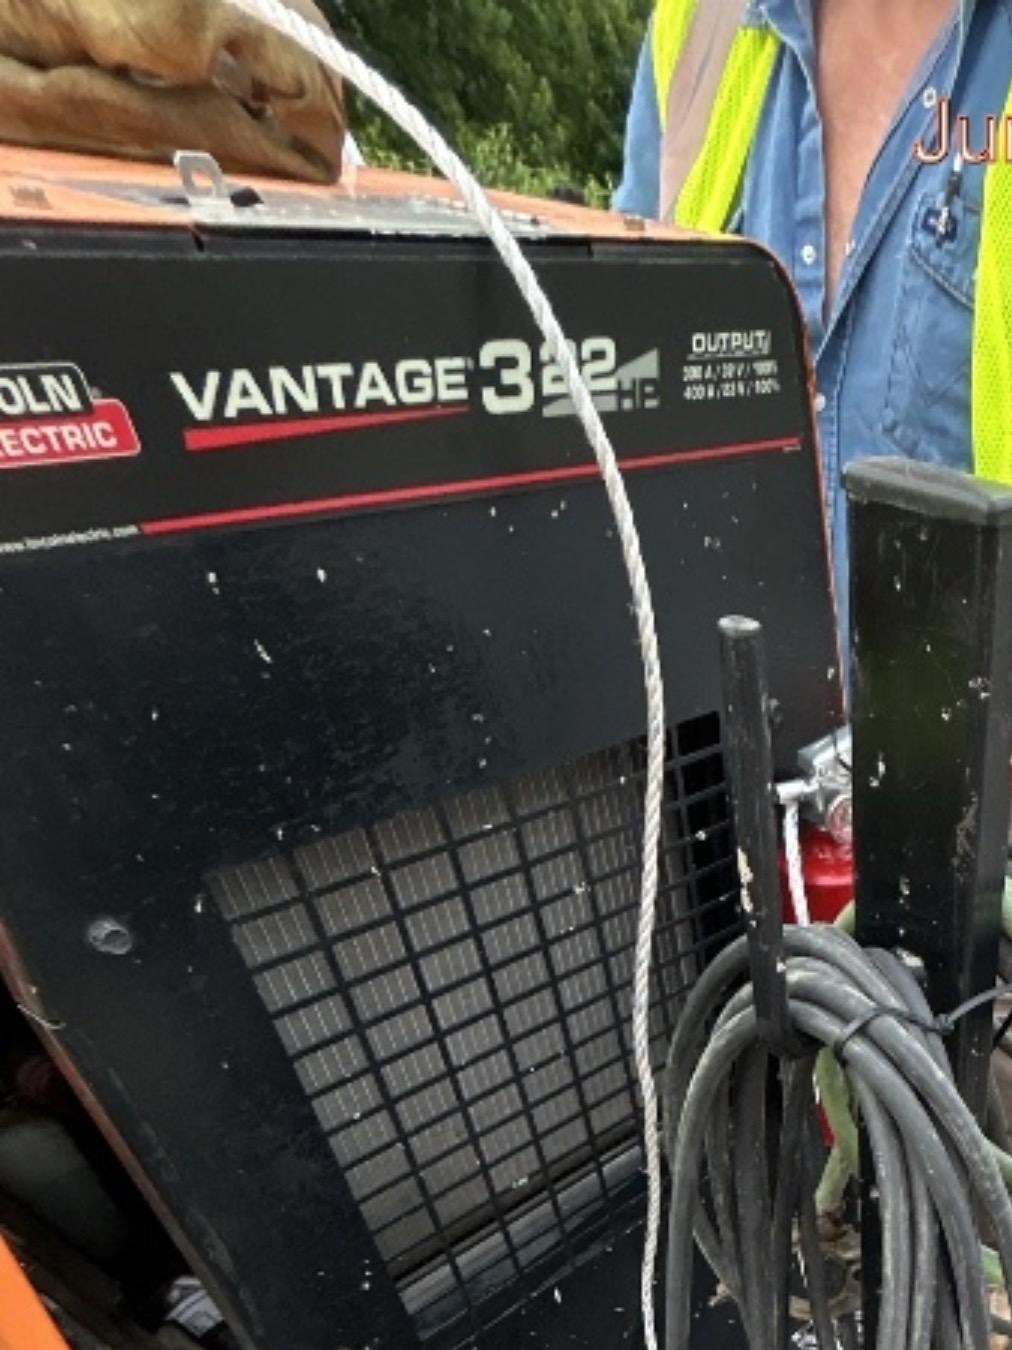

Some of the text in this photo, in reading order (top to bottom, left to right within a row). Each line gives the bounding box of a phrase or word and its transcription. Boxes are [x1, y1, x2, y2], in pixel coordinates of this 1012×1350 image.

[692, 330, 766, 352] OUTPUT
[169, 356, 470, 421] VANTAGE
[0, 421, 118, 458] ECTRIC
